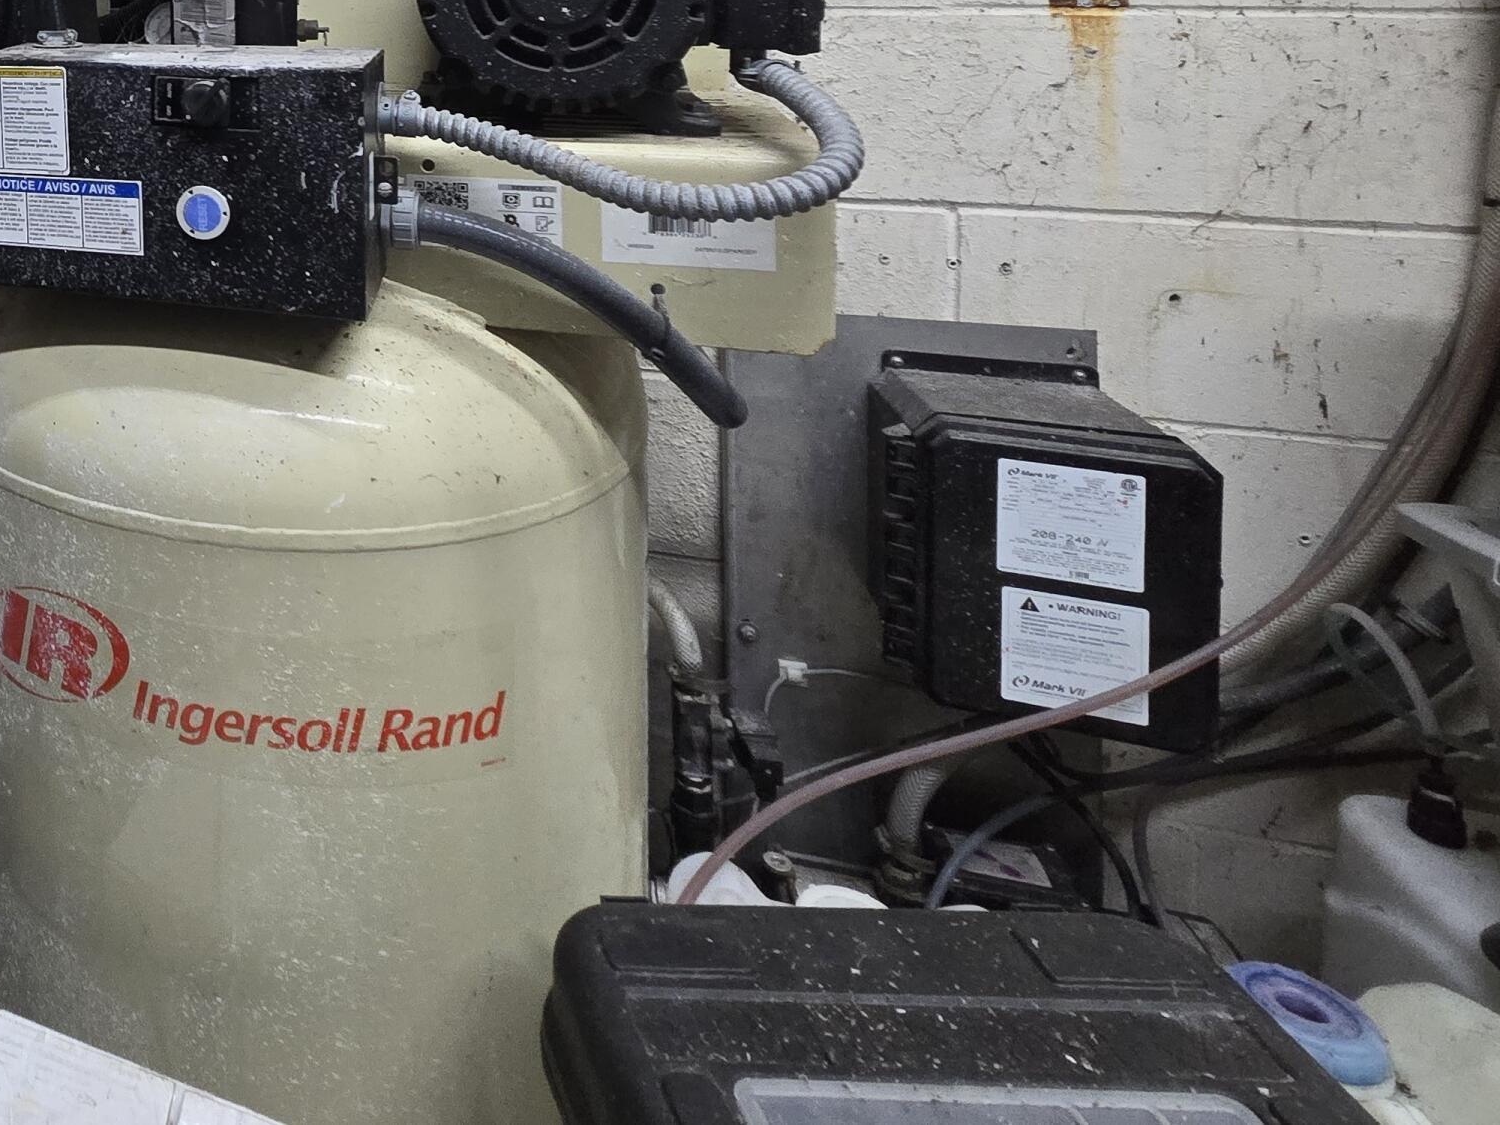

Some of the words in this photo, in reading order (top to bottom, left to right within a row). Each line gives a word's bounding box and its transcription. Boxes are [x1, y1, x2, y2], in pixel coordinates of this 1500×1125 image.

[44, 181, 80, 194] AVISO
[89, 183, 116, 195] AVIS
[1031, 528, 1092, 546] 208-240
[1056, 602, 1122, 621] WARNING!
[2, 589, 98, 700] IR
[132, 680, 367, 753] Ingersoll
[376, 690, 507, 753] Rand
[1031, 679, 1065, 693] Mark
